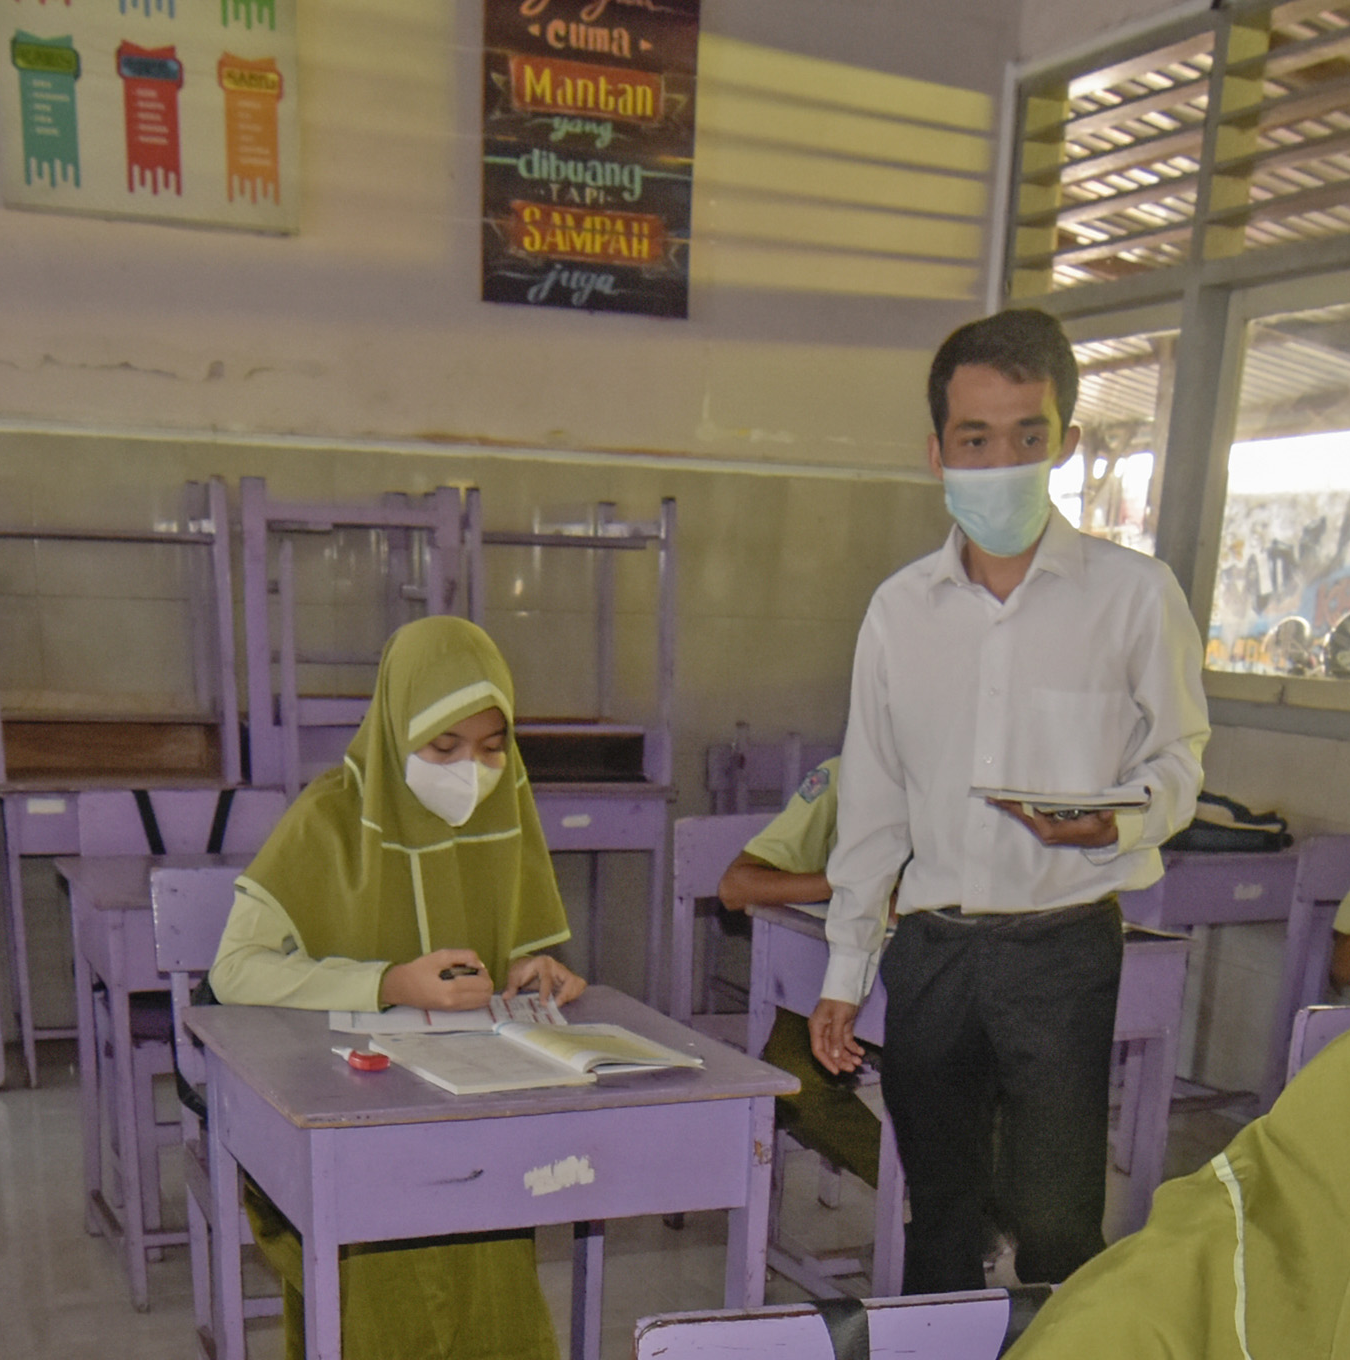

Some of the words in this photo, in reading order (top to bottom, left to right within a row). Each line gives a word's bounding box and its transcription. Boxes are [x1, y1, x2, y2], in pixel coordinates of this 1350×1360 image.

[546, 19, 631, 58] cuma
[524, 64, 653, 116] Mantan
[548, 115, 616, 149] yang
[518, 148, 643, 202] dibuang
[523, 206, 650, 259] SAMPAH
[528, 264, 619, 306] juga
